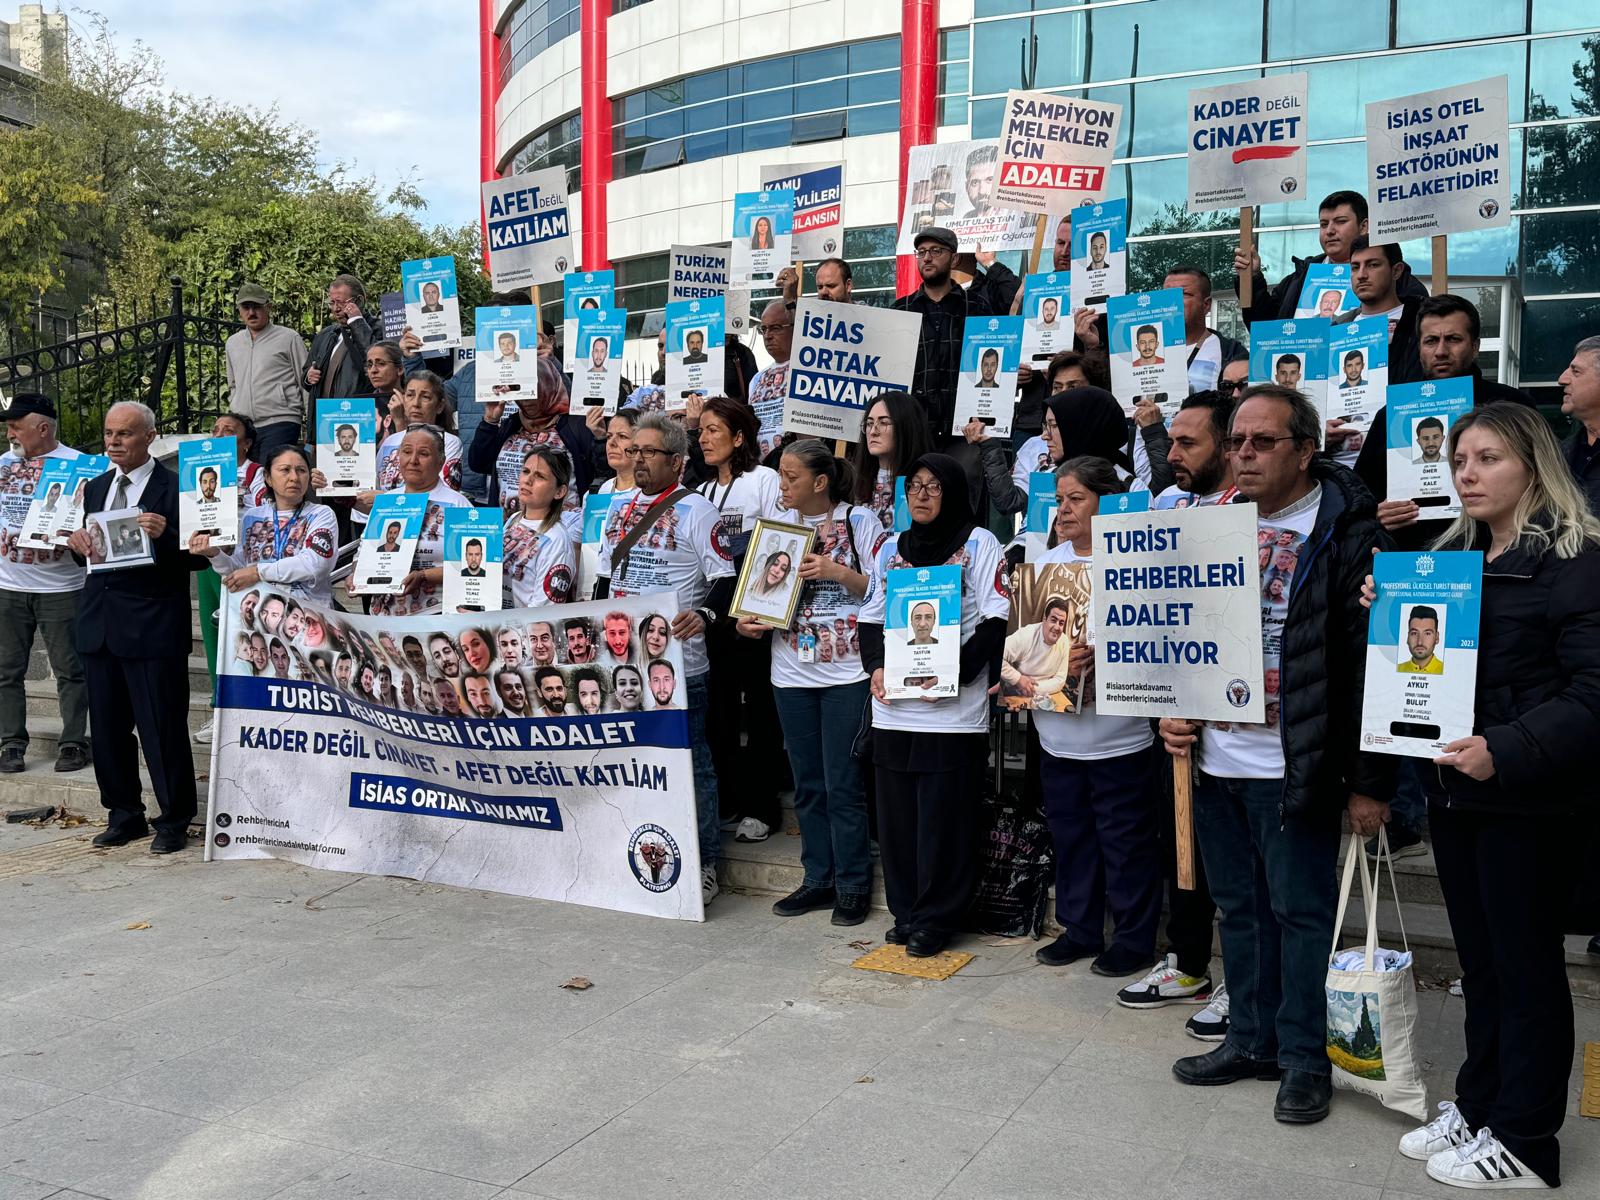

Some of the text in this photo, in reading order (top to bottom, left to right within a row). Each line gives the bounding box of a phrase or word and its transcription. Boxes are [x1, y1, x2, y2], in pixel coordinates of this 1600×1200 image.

[1011, 98, 1114, 128] ŞAMPİYON
[1194, 96, 1301, 121] KADER DEĞİL
[1387, 97, 1484, 130] İSİAS OTEL
[1008, 119, 1110, 148] MELEKLER
[1193, 116, 1301, 151] CİNAYET
[1403, 124, 1468, 150] İNŞAAT
[1004, 136, 1044, 160] İÇİN
[1376, 143, 1499, 180] SEKTÖRÜNÜN
[764, 178, 801, 192] KAMU
[1002, 166, 1100, 188] ADALET
[1377, 168, 1499, 203] FELAKETİDİR!
[490, 187, 564, 218] AFET DEĞİL
[793, 185, 840, 208] EVLİLERİ
[492, 215, 566, 248] KATLİAM
[792, 210, 838, 231] ILANSIN
[945, 219, 972, 228] UMUT
[997, 214, 1016, 223] TAN
[674, 253, 726, 269] TURİZM
[674, 270, 730, 284] BAKANL
[384, 316, 406, 324] HAZIRL
[802, 311, 864, 344] İSİAS
[458, 348, 476, 360] RE
[799, 346, 881, 376] ORTAK
[794, 374, 902, 406] DAVAM
[1104, 524, 1180, 554] TURİST
[1105, 556, 1245, 590] REHBERLERİ
[1412, 581, 1432, 590] ÜLKESEL
[1434, 582, 1450, 590] TURİST
[1106, 603, 1194, 626] ADALET
[1107, 636, 1218, 664] BEKLİYOR
[268, 684, 636, 750] TURİST REHBERLERİ İÇİN ADALET
[240, 726, 306, 753] KADER
[313, 729, 370, 759] DEĞİL
[375, 737, 441, 776] CİNAYET
[456, 760, 502, 784] AFET
[508, 761, 574, 786] DEĞİL
[574, 758, 668, 792] KATLİAM
[360, 779, 552, 824] İSİAS ORTAK DAVAMIZ
[236, 815, 290, 829] RehberlericinA
